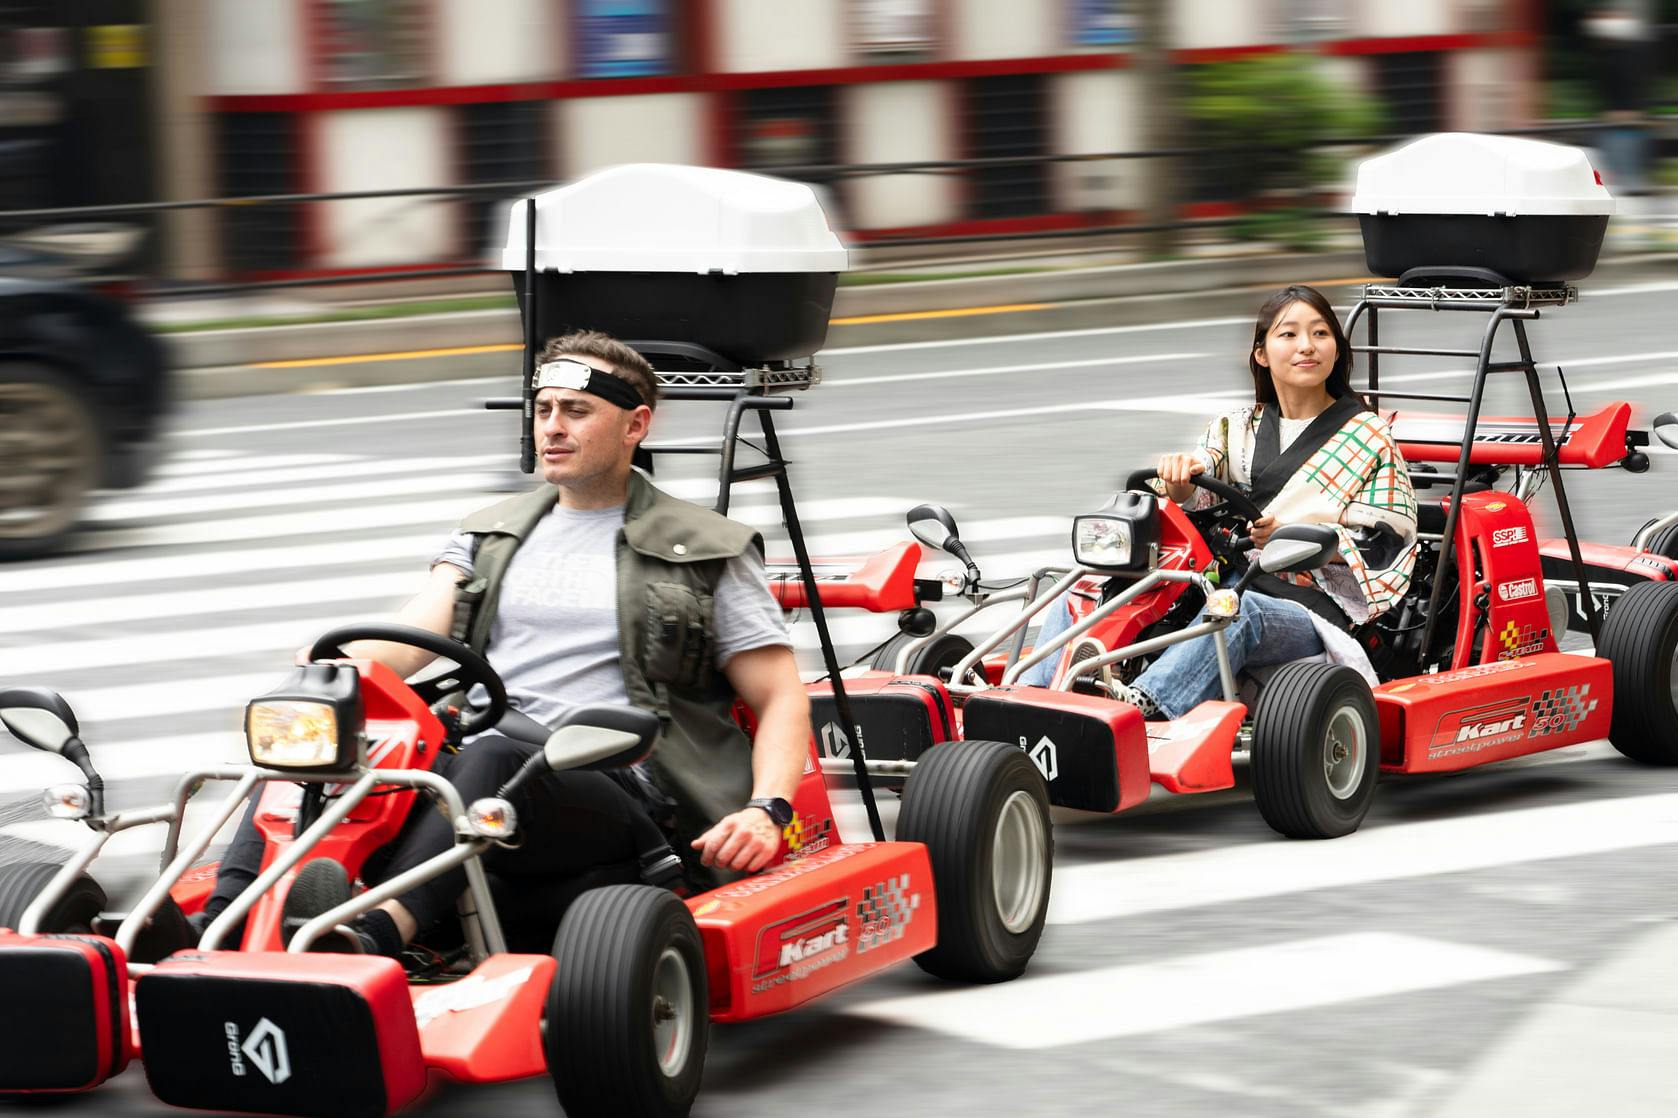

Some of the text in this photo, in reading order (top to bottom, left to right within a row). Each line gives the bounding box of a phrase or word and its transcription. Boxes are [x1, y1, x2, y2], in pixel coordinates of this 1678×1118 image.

[1508, 580, 1536, 598] Castrol
[1457, 714, 1566, 742] Kart 50
[779, 916, 890, 966] Kart 50
